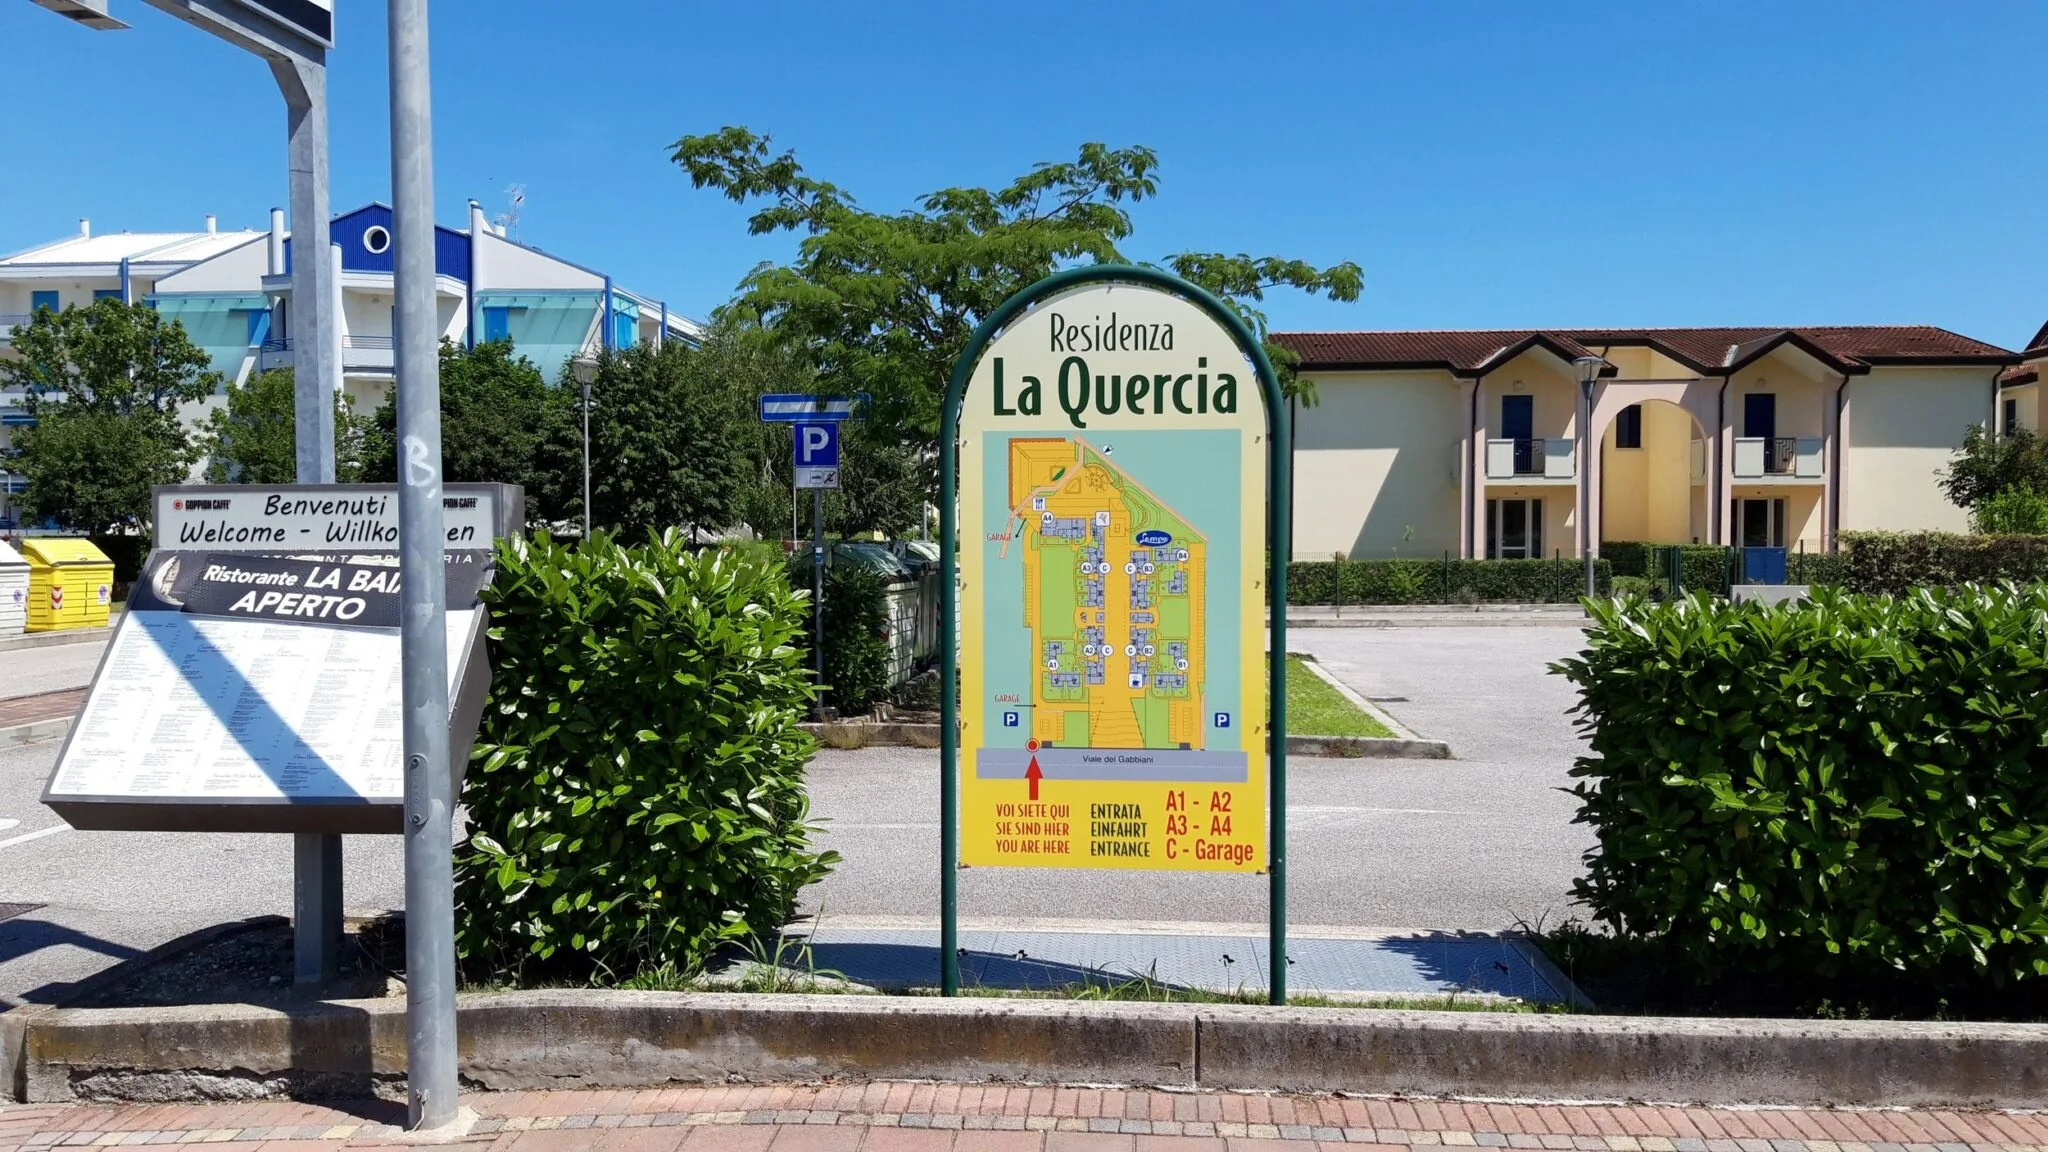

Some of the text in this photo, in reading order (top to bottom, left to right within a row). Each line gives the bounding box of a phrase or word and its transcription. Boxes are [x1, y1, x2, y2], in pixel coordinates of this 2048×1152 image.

[1050, 312, 1174, 352] Residenza
[993, 356, 1237, 428] La Quercia
[802, 427, 829, 462] P
[185, 499, 212, 510] GOPPION
[264, 494, 388, 516] Benvenuti
[180, 520, 286, 544] Welcome
[325, 519, 475, 543] Willkoen
[986, 533, 1012, 542] GARAGE
[202, 564, 400, 594] Ristorante LA BAI
[228, 590, 367, 621] APERTO
[995, 694, 1020, 702] GARAGE
[1006, 714, 1016, 726] P
[1217, 715, 1228, 726] P
[1083, 755, 1154, 764] Viale dei Gabbiani
[1166, 790, 1185, 812] A1
[1210, 791, 1232, 812] A2
[996, 803, 1070, 821] VOI SIETE QUI
[1090, 803, 1142, 820] ENTRATA
[996, 822, 1070, 836] SIE SIND HIER
[1090, 821, 1148, 838] EINFAHRT
[1166, 814, 1188, 836] A3
[1210, 815, 1232, 836] A4
[996, 839, 1071, 854] YOU ARE HERE
[1090, 840, 1151, 858] ENTRANCE
[1166, 838, 1177, 860] C
[1195, 838, 1254, 866] Garage
